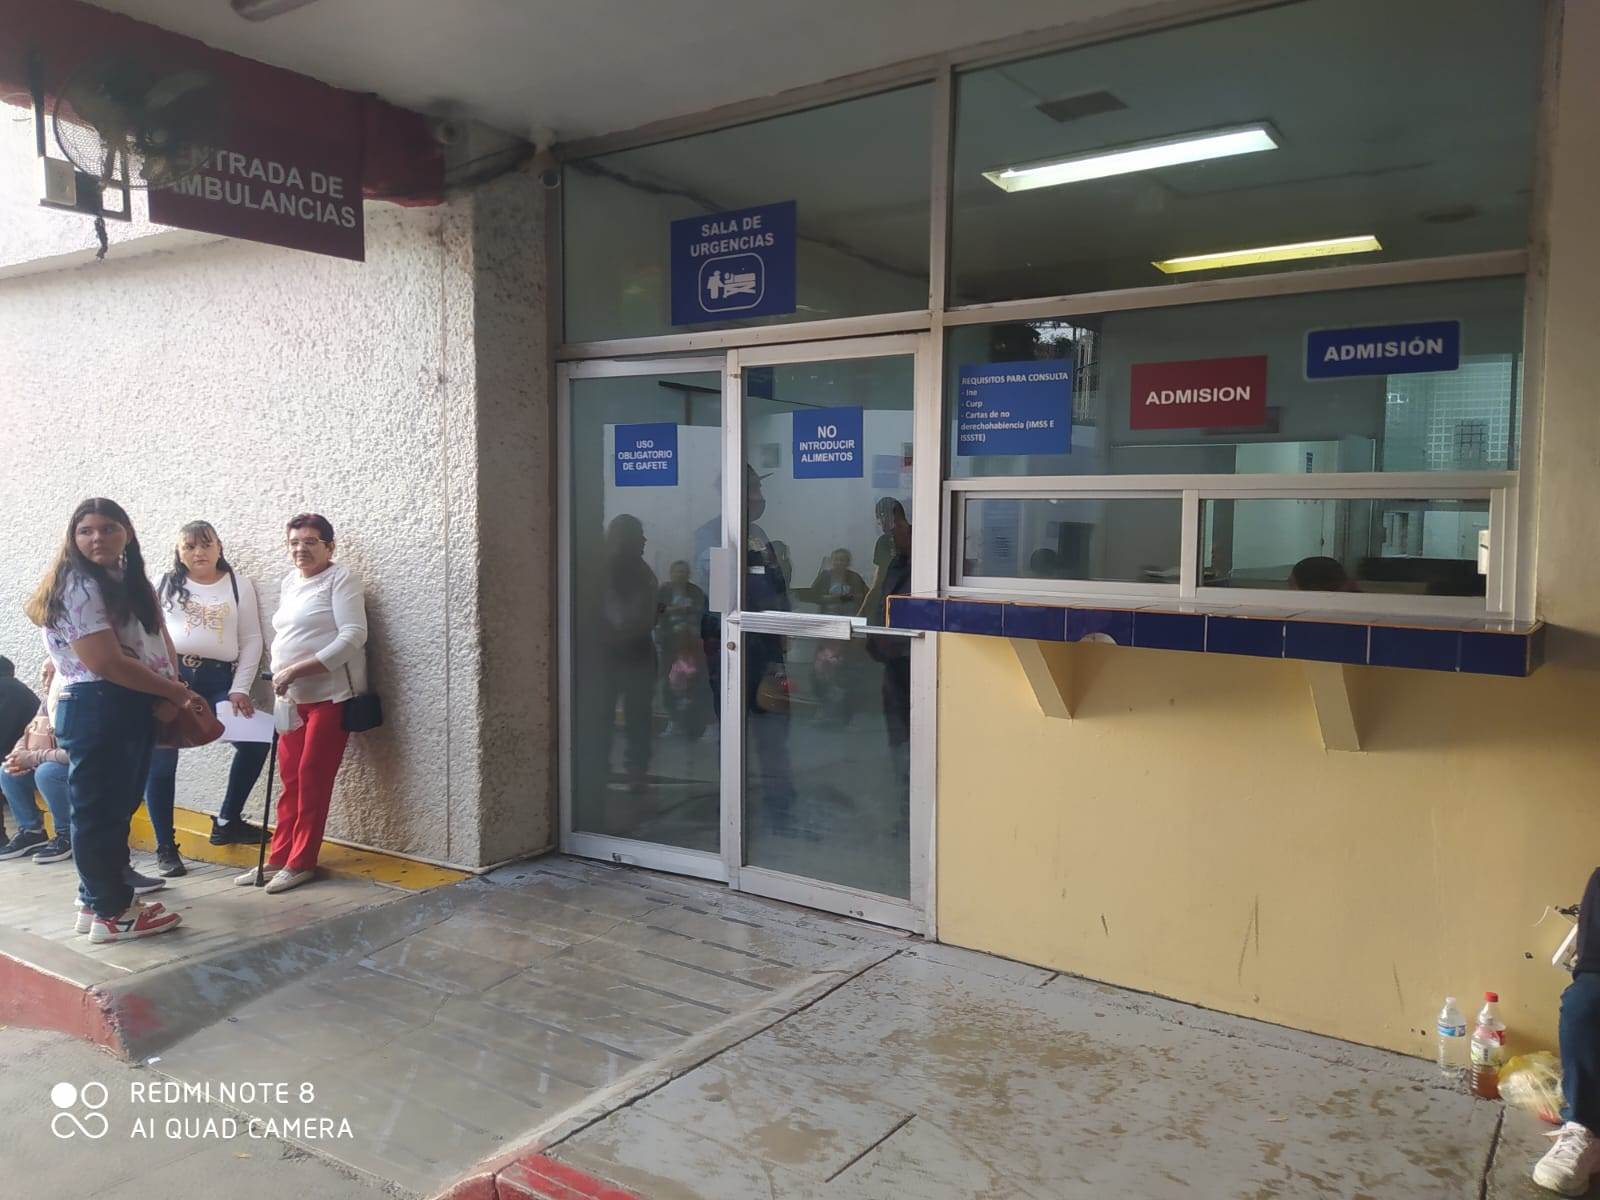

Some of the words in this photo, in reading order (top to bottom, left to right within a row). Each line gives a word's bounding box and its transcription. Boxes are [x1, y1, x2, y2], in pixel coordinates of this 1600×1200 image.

[177, 143, 305, 191] NTRADA
[311, 172, 345, 200] DE
[701, 219, 738, 237] SALA
[743, 215, 762, 231] DE
[690, 232, 775, 257] URGENCIAS
[1324, 336, 1444, 362] ADMISIÓN
[962, 375, 1006, 385] REQUISITOS
[1006, 374, 1027, 382] PARA
[1028, 372, 1068, 382] CONSULTA
[1145, 385, 1251, 406] ADMISION
[965, 400, 983, 409] Curp
[965, 411, 988, 419] Cartas
[989, 410, 999, 418] de
[960, 420, 1024, 430] derechohabiencia
[1026, 419, 1048, 430] (IMSS
[817, 425, 838, 439] NO
[960, 433, 986, 443] ISSSTE)
[635, 440, 654, 449] USO
[799, 439, 855, 451] INTRODUCIR
[617, 450, 673, 460] OBLIGATORIO
[801, 451, 854, 463] ALIMENTOS
[622, 462, 634, 471] DE
[635, 461, 668, 470] GAFETE
